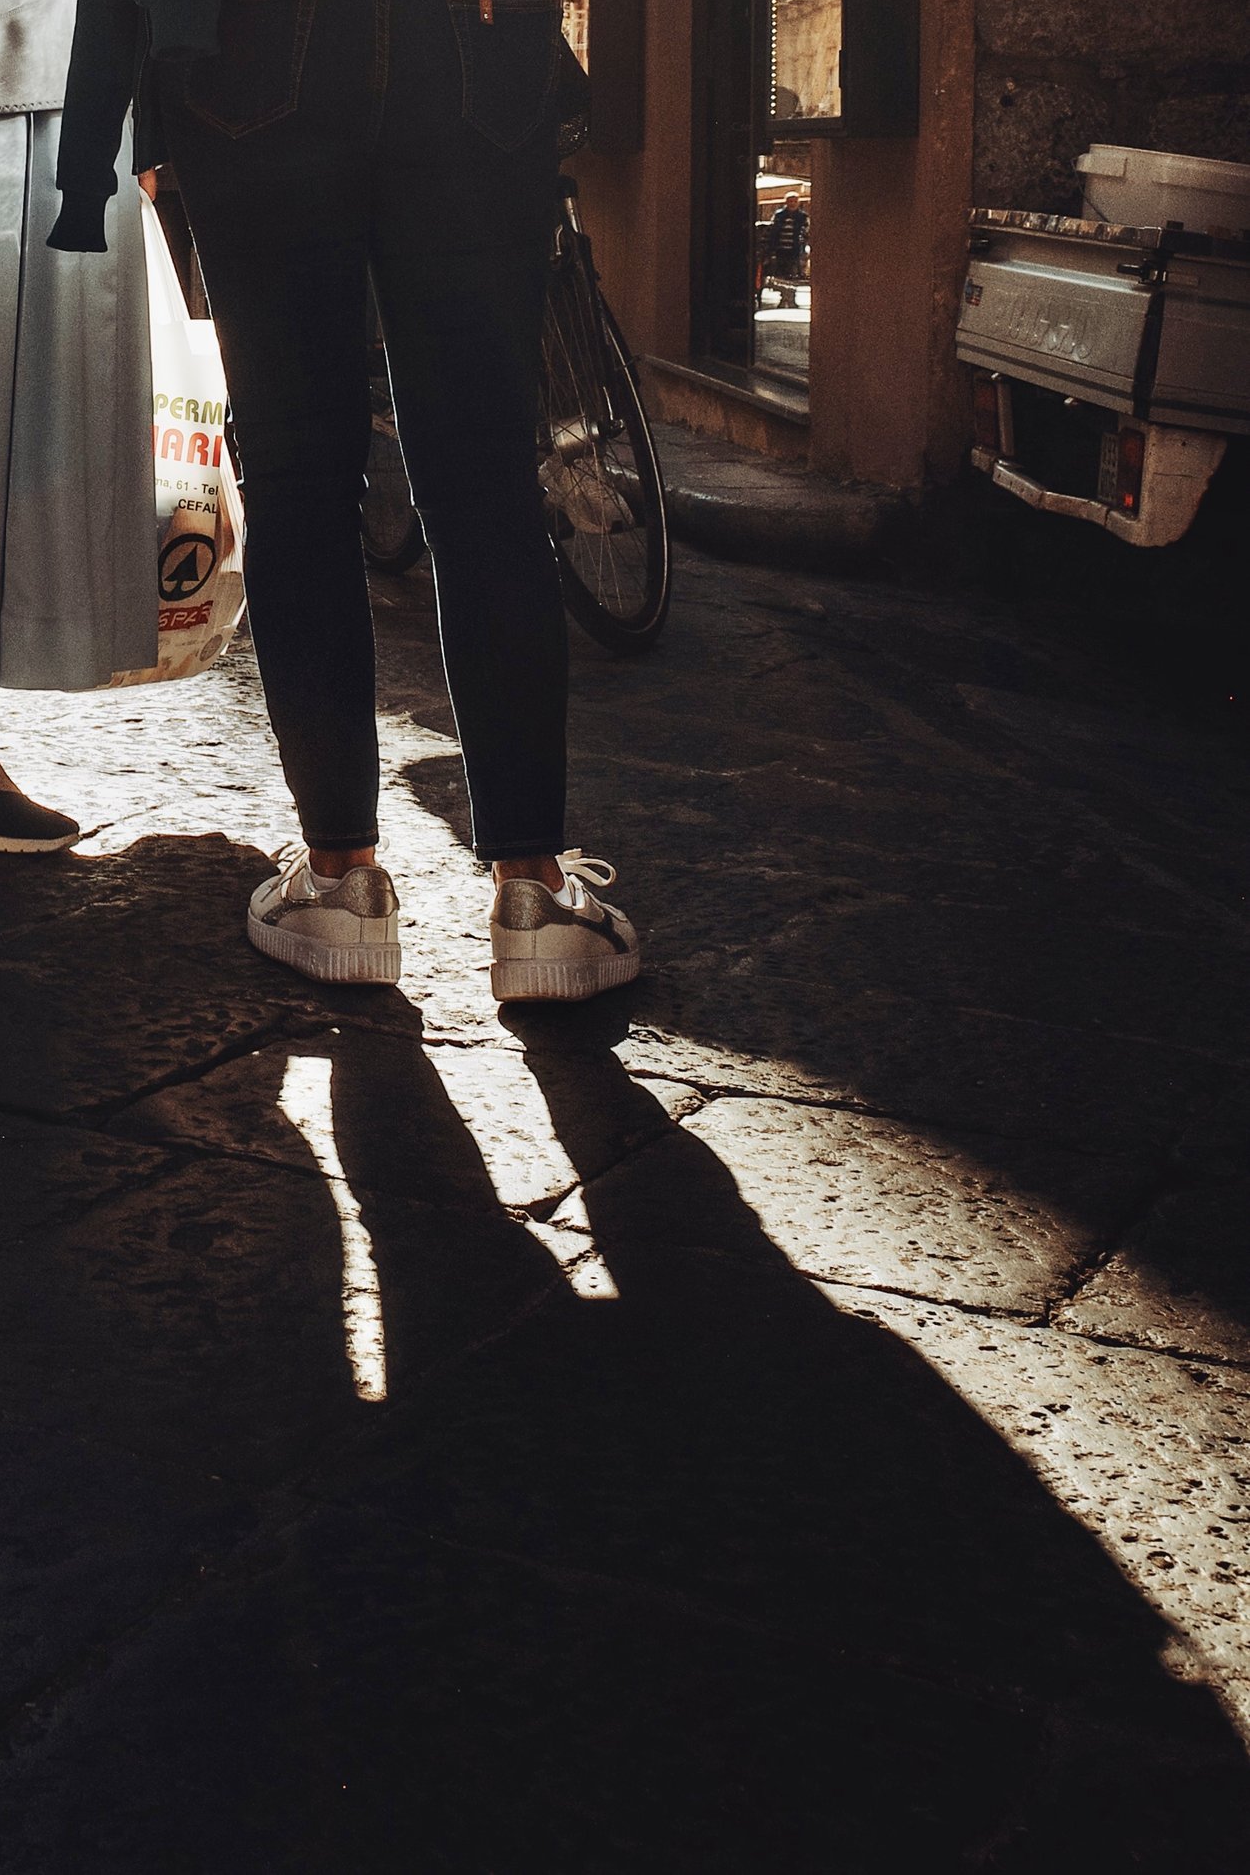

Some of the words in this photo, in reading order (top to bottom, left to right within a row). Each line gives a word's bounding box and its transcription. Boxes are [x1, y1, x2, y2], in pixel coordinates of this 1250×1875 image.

[153, 393, 223, 426] PERM
[176, 479, 189, 492] 61
[178, 498, 218, 514] CEFAL
